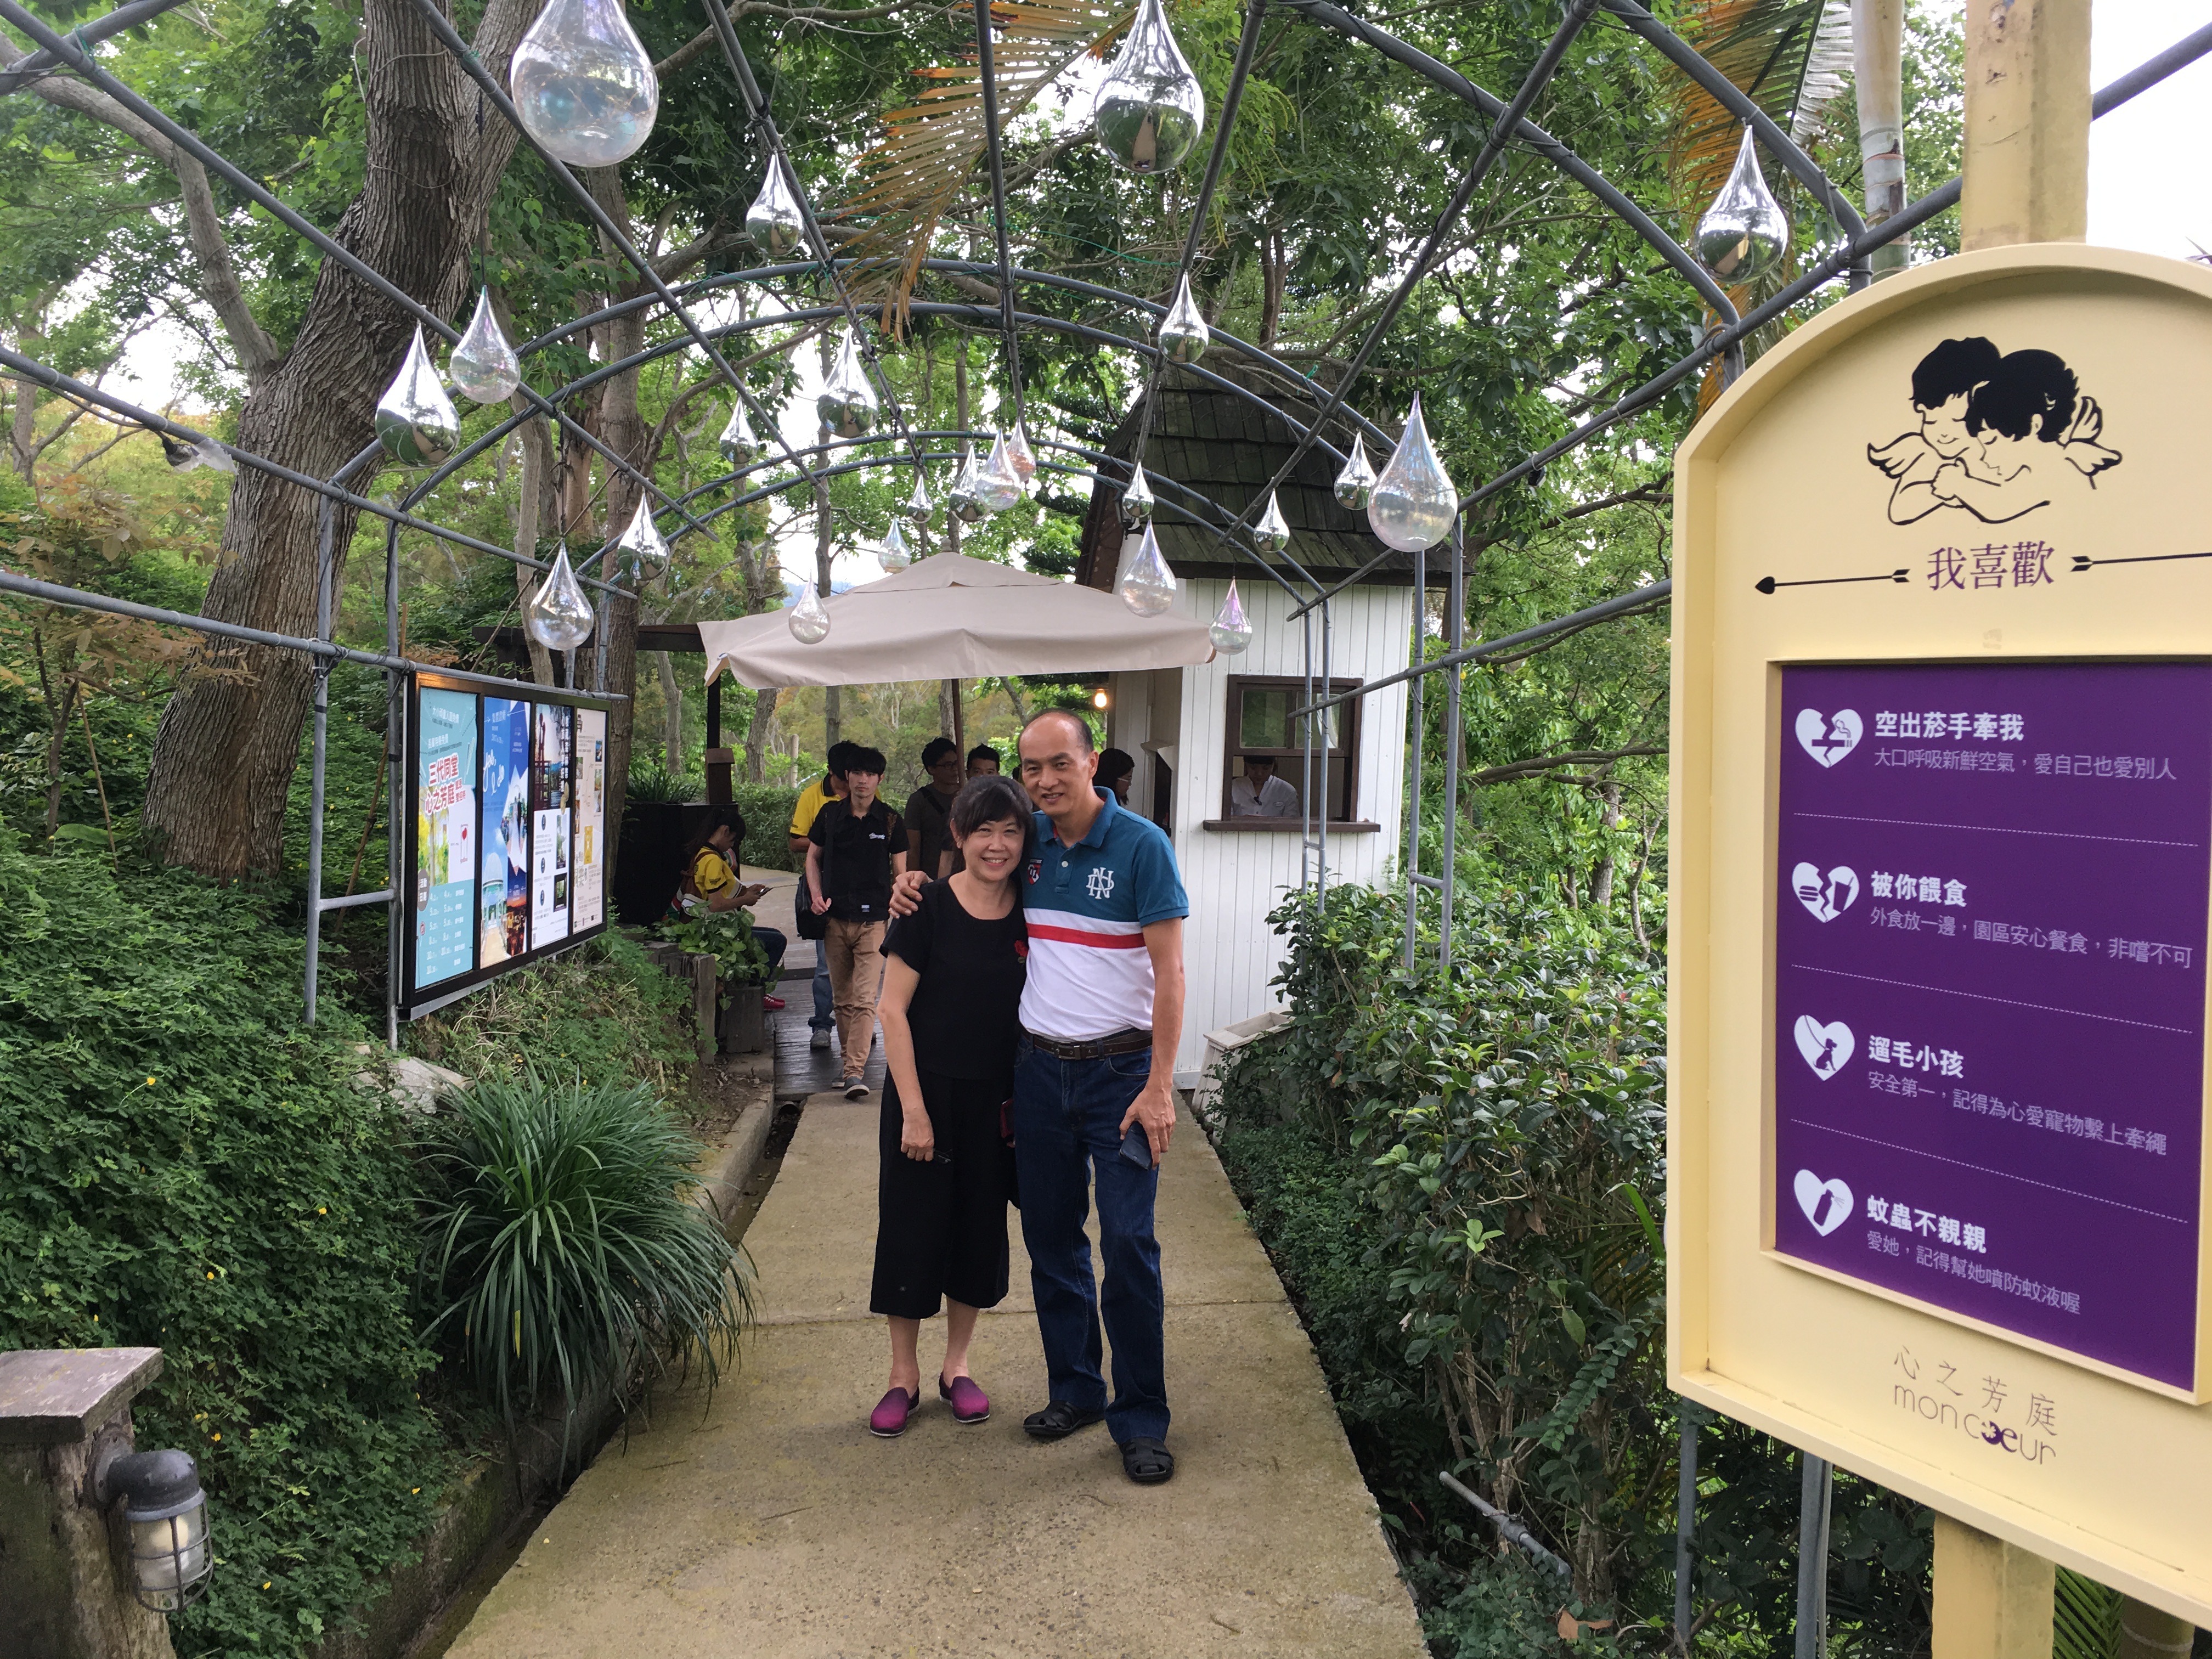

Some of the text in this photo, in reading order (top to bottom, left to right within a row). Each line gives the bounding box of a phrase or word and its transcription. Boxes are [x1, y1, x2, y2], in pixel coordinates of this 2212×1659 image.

[1927, 540, 2056, 591] 我喜歡
[1875, 710, 2025, 741] 空出菸手牽我
[430, 754, 458, 785] 三代同堂
[425, 783, 455, 814] 心之芳庭
[1871, 870, 1967, 907] 被你餵食
[1869, 1035, 1965, 1079] 遛毛小孩
[1866, 1194, 1987, 1254] 蚊蟲不親親
[1894, 1344, 2058, 1436] 心之芳庭
